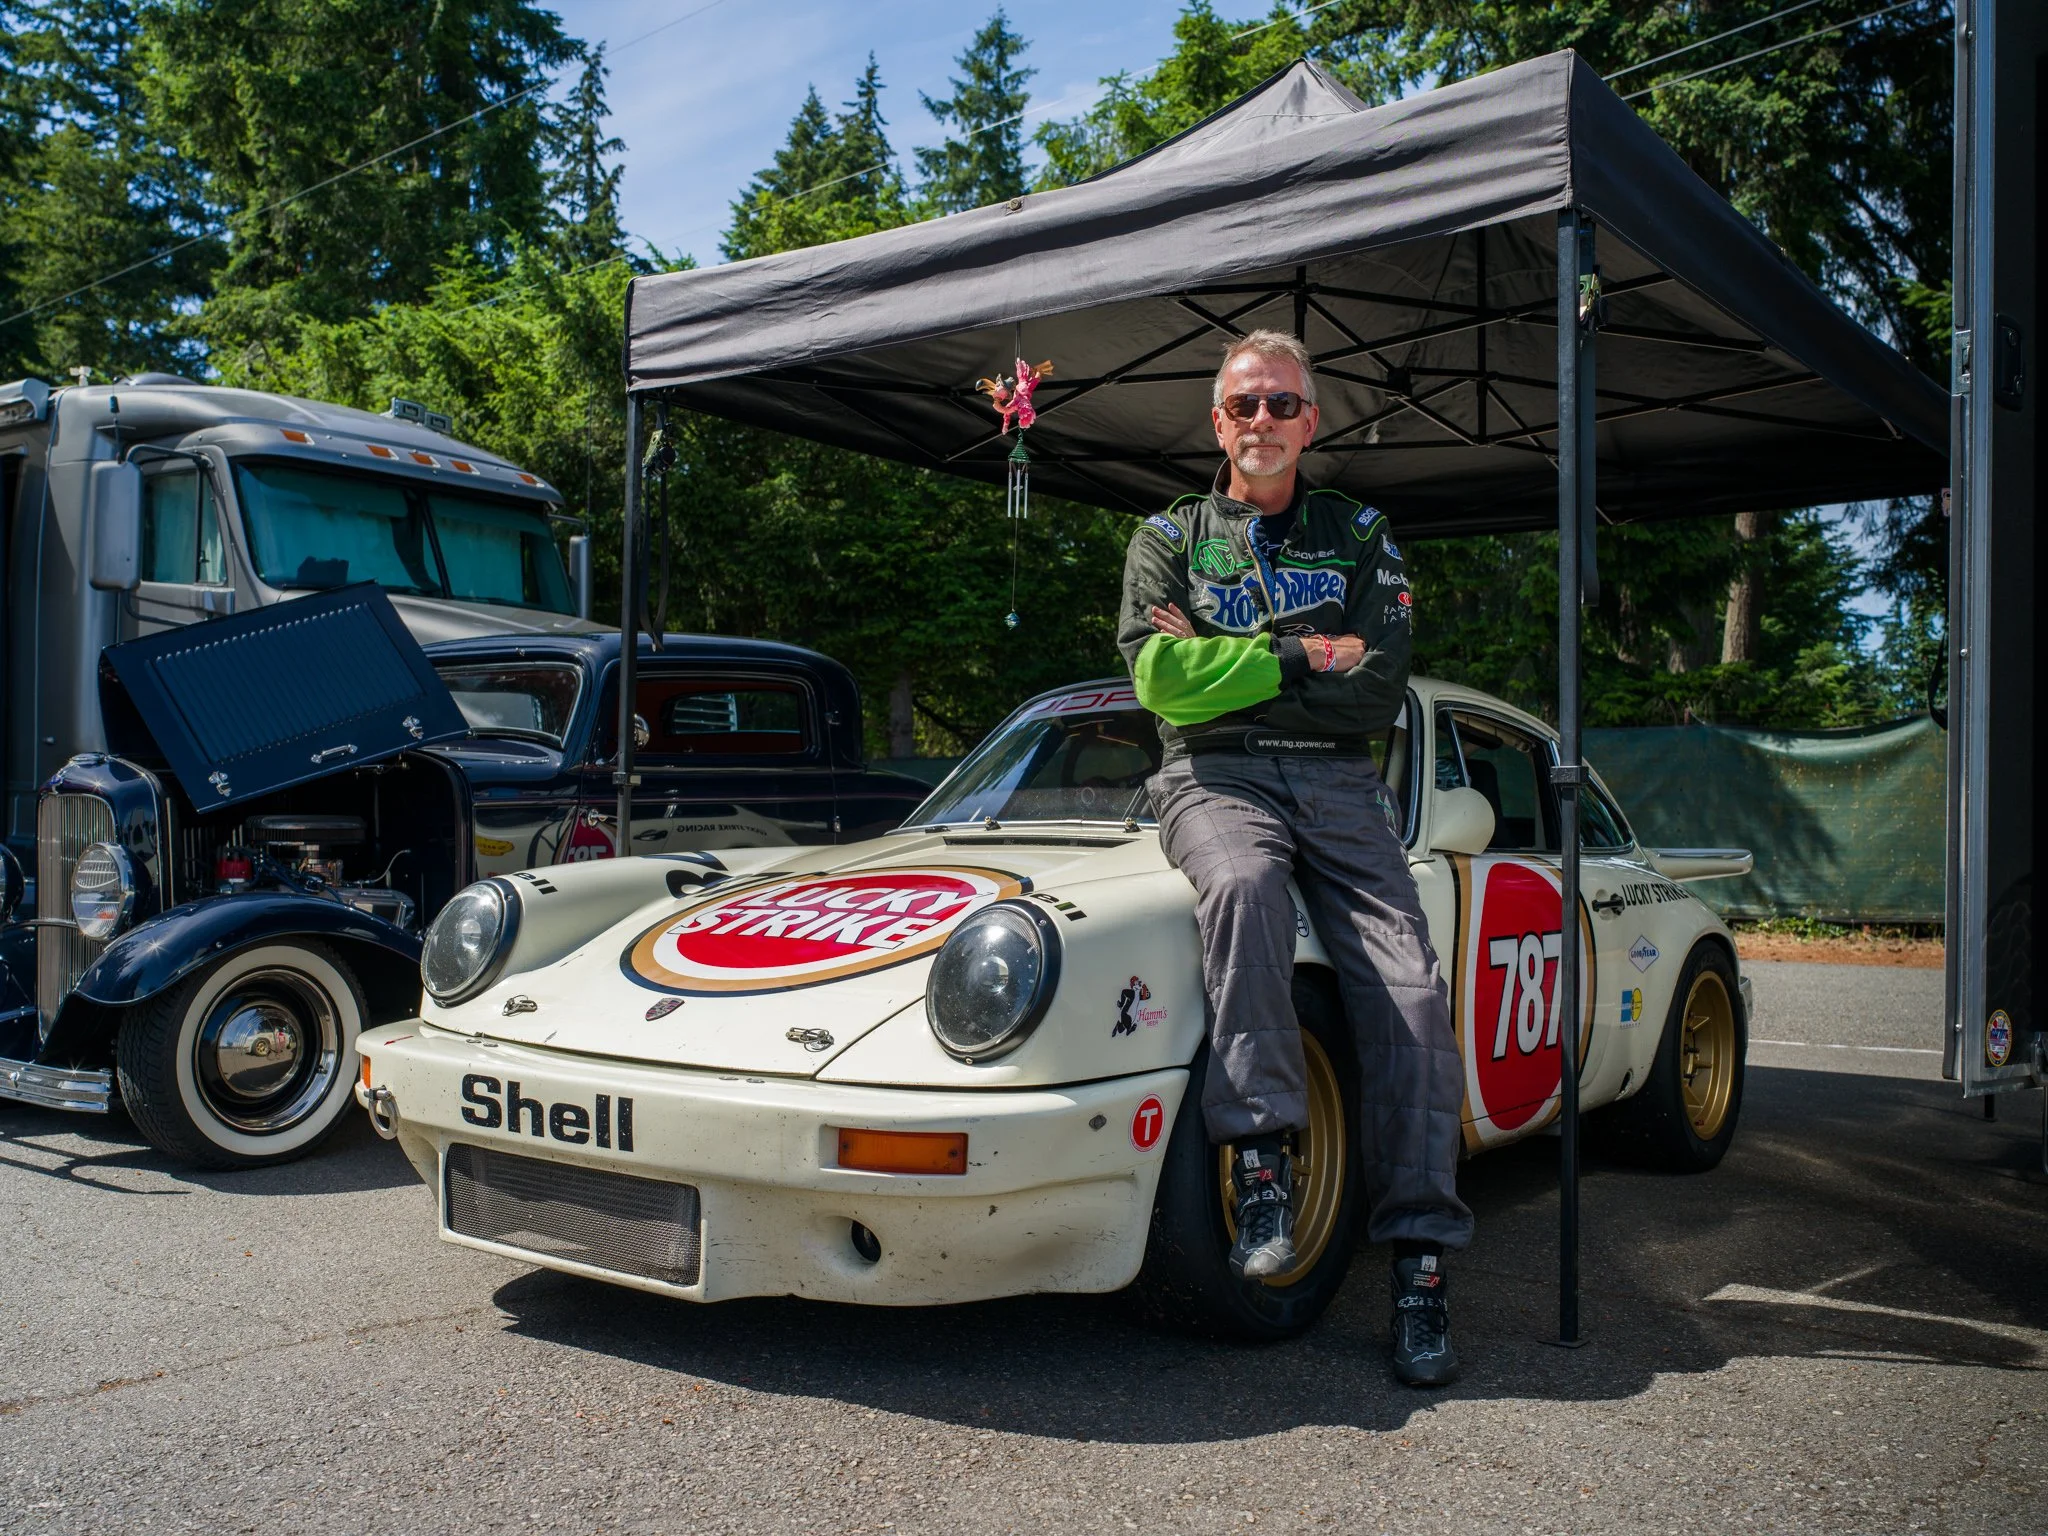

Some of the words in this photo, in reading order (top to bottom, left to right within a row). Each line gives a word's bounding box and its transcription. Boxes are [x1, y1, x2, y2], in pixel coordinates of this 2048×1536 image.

[1145, 516, 1180, 537] sparco
[1198, 542, 1236, 577] MG
[1257, 739, 1336, 749] www.mg.xpower.com
[733, 881, 996, 916] LUCKY
[1621, 884, 1653, 907] LUCKY
[1651, 883, 1690, 904] STRIKE
[667, 907, 943, 950] STRIKE
[1488, 930, 1563, 1063] 787
[1137, 1006, 1168, 1022] Hamm's
[460, 1073, 634, 1152] Shell
[1140, 1107, 1159, 1141] T
